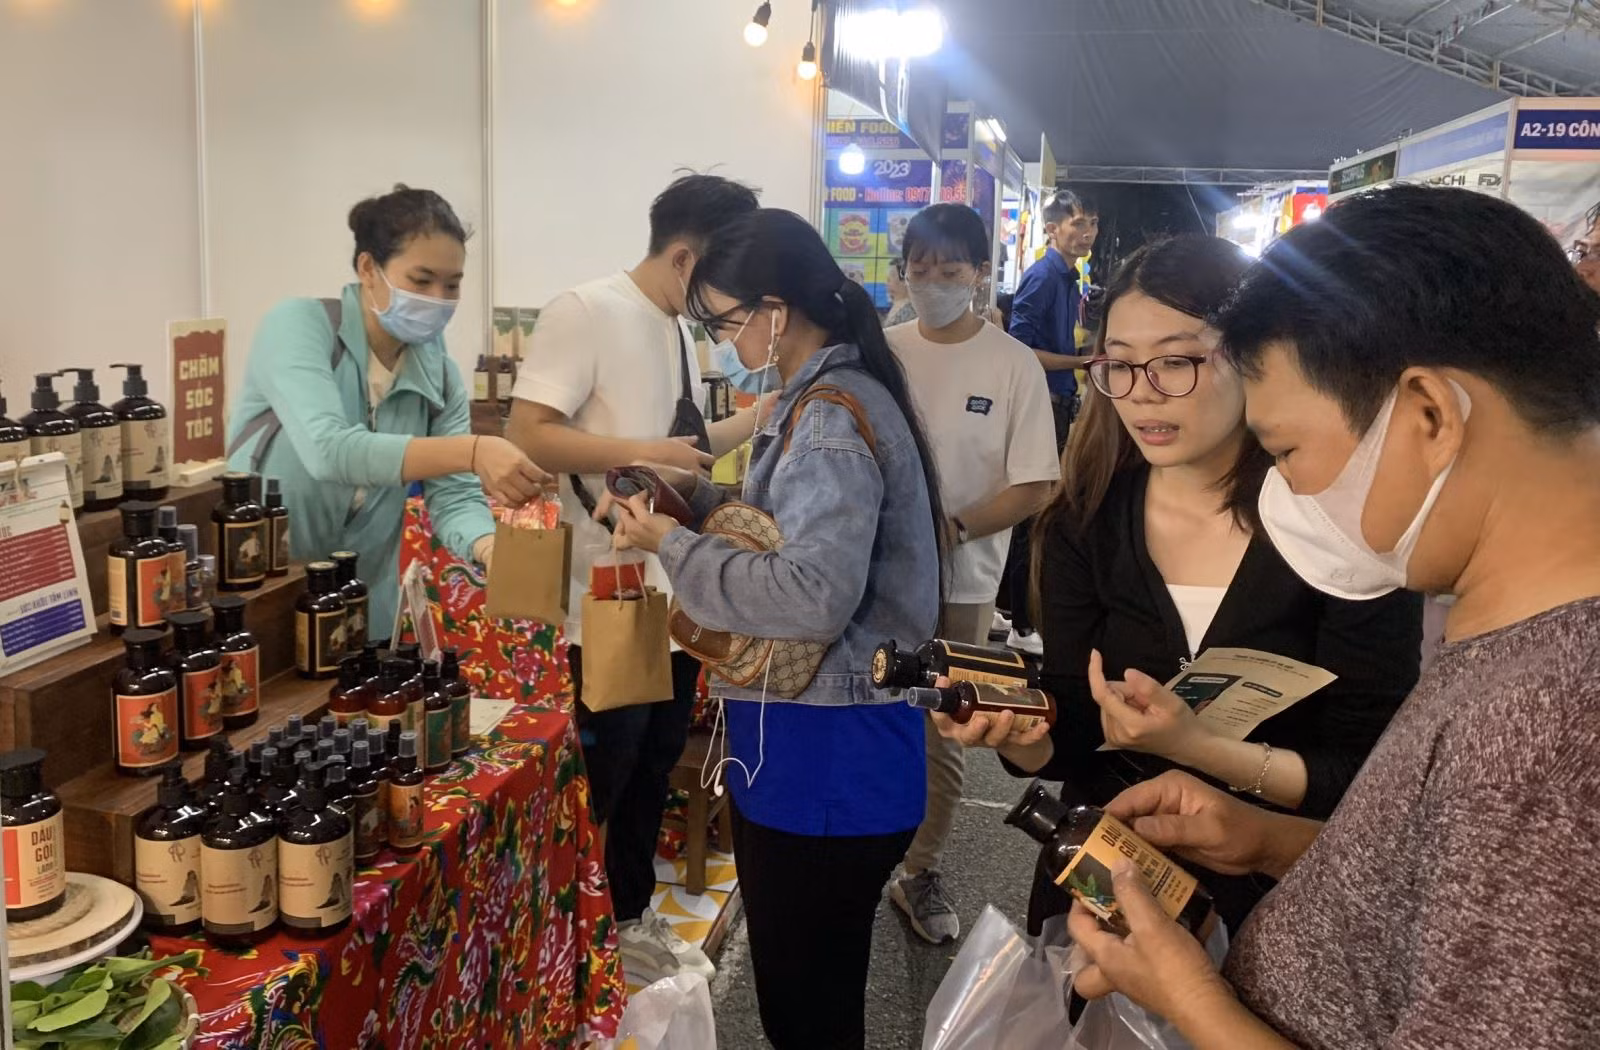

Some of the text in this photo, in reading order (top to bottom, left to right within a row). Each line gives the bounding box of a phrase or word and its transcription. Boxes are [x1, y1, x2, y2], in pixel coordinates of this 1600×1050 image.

[1520, 122, 1566, 137] A2-19
[874, 160, 911, 178] 2023
[179, 353, 220, 380] CHĂM
